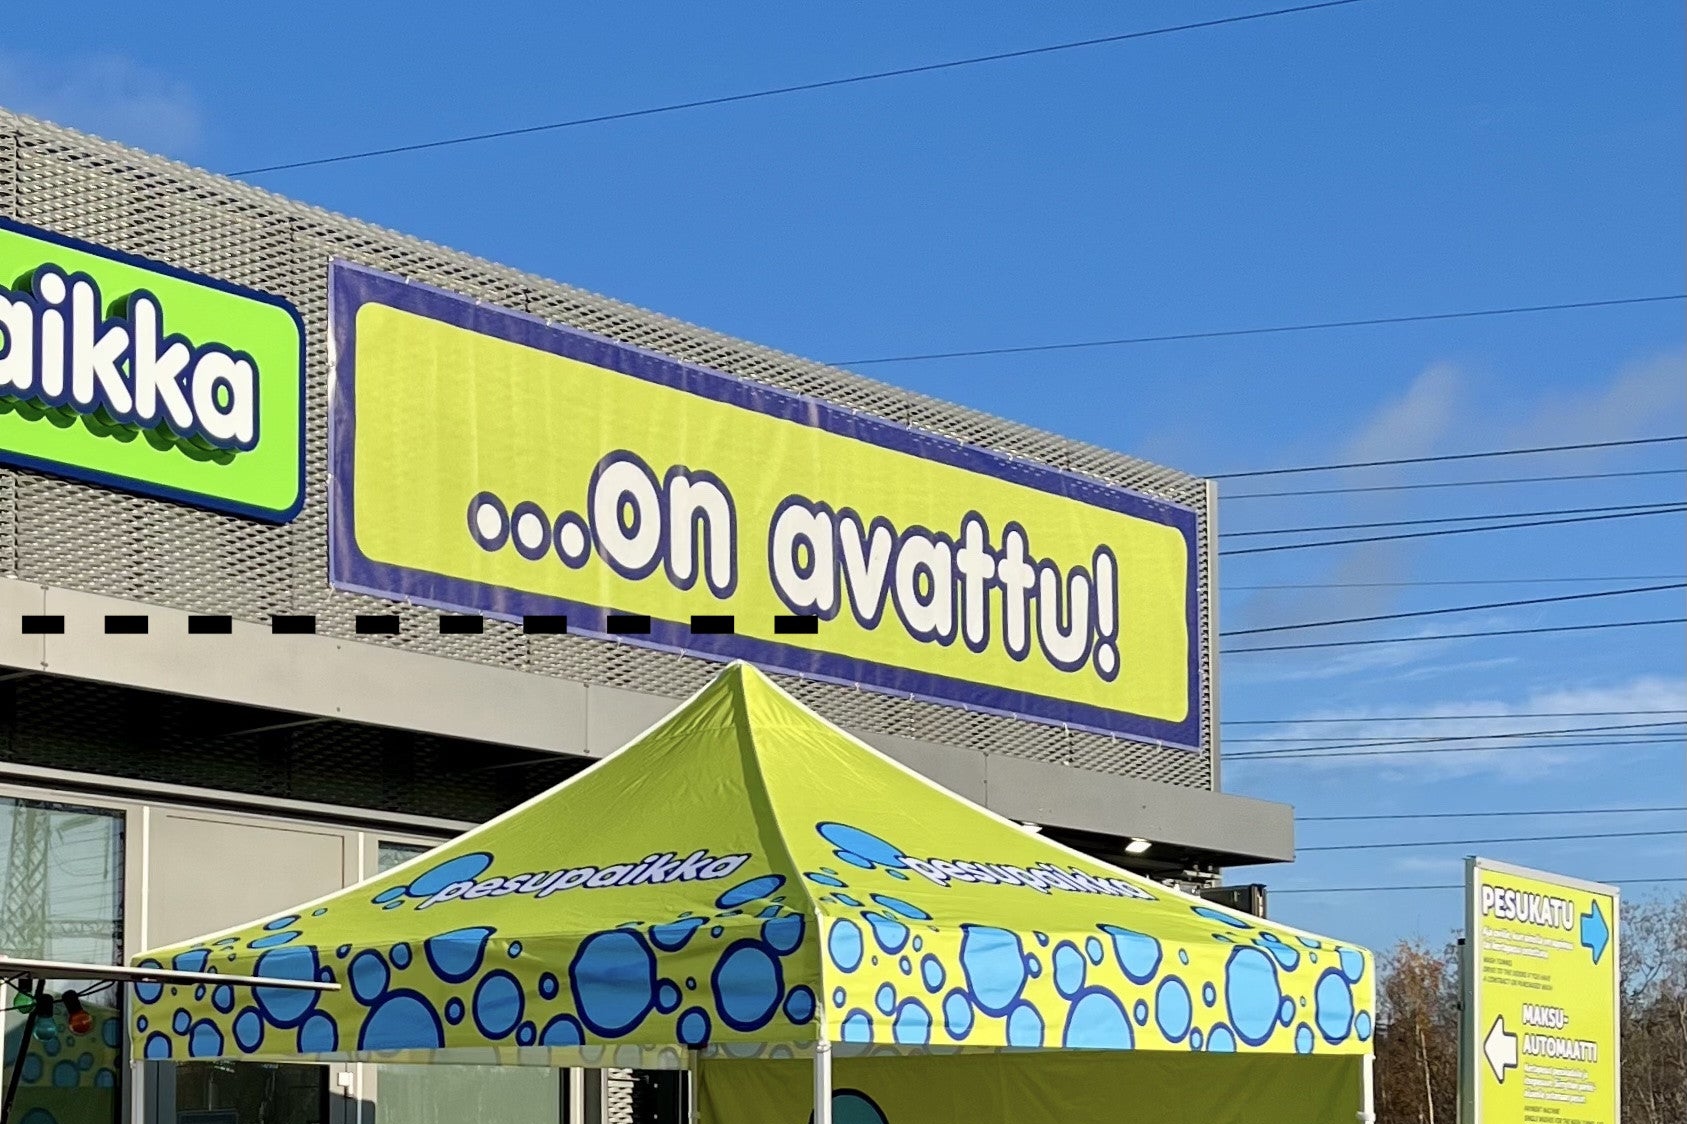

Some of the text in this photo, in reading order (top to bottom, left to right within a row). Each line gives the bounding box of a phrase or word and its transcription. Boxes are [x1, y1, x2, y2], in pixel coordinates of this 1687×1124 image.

[769, 494, 1120, 682] avattu!
[415, 850, 752, 910] pesupaikka
[895, 855, 1159, 901] pesupaikka
[1481, 884, 1574, 931] PESUKATU
[1522, 1003, 1569, 1030] MAKSU-
[1522, 1033, 1598, 1063] AUTOMAATTI
